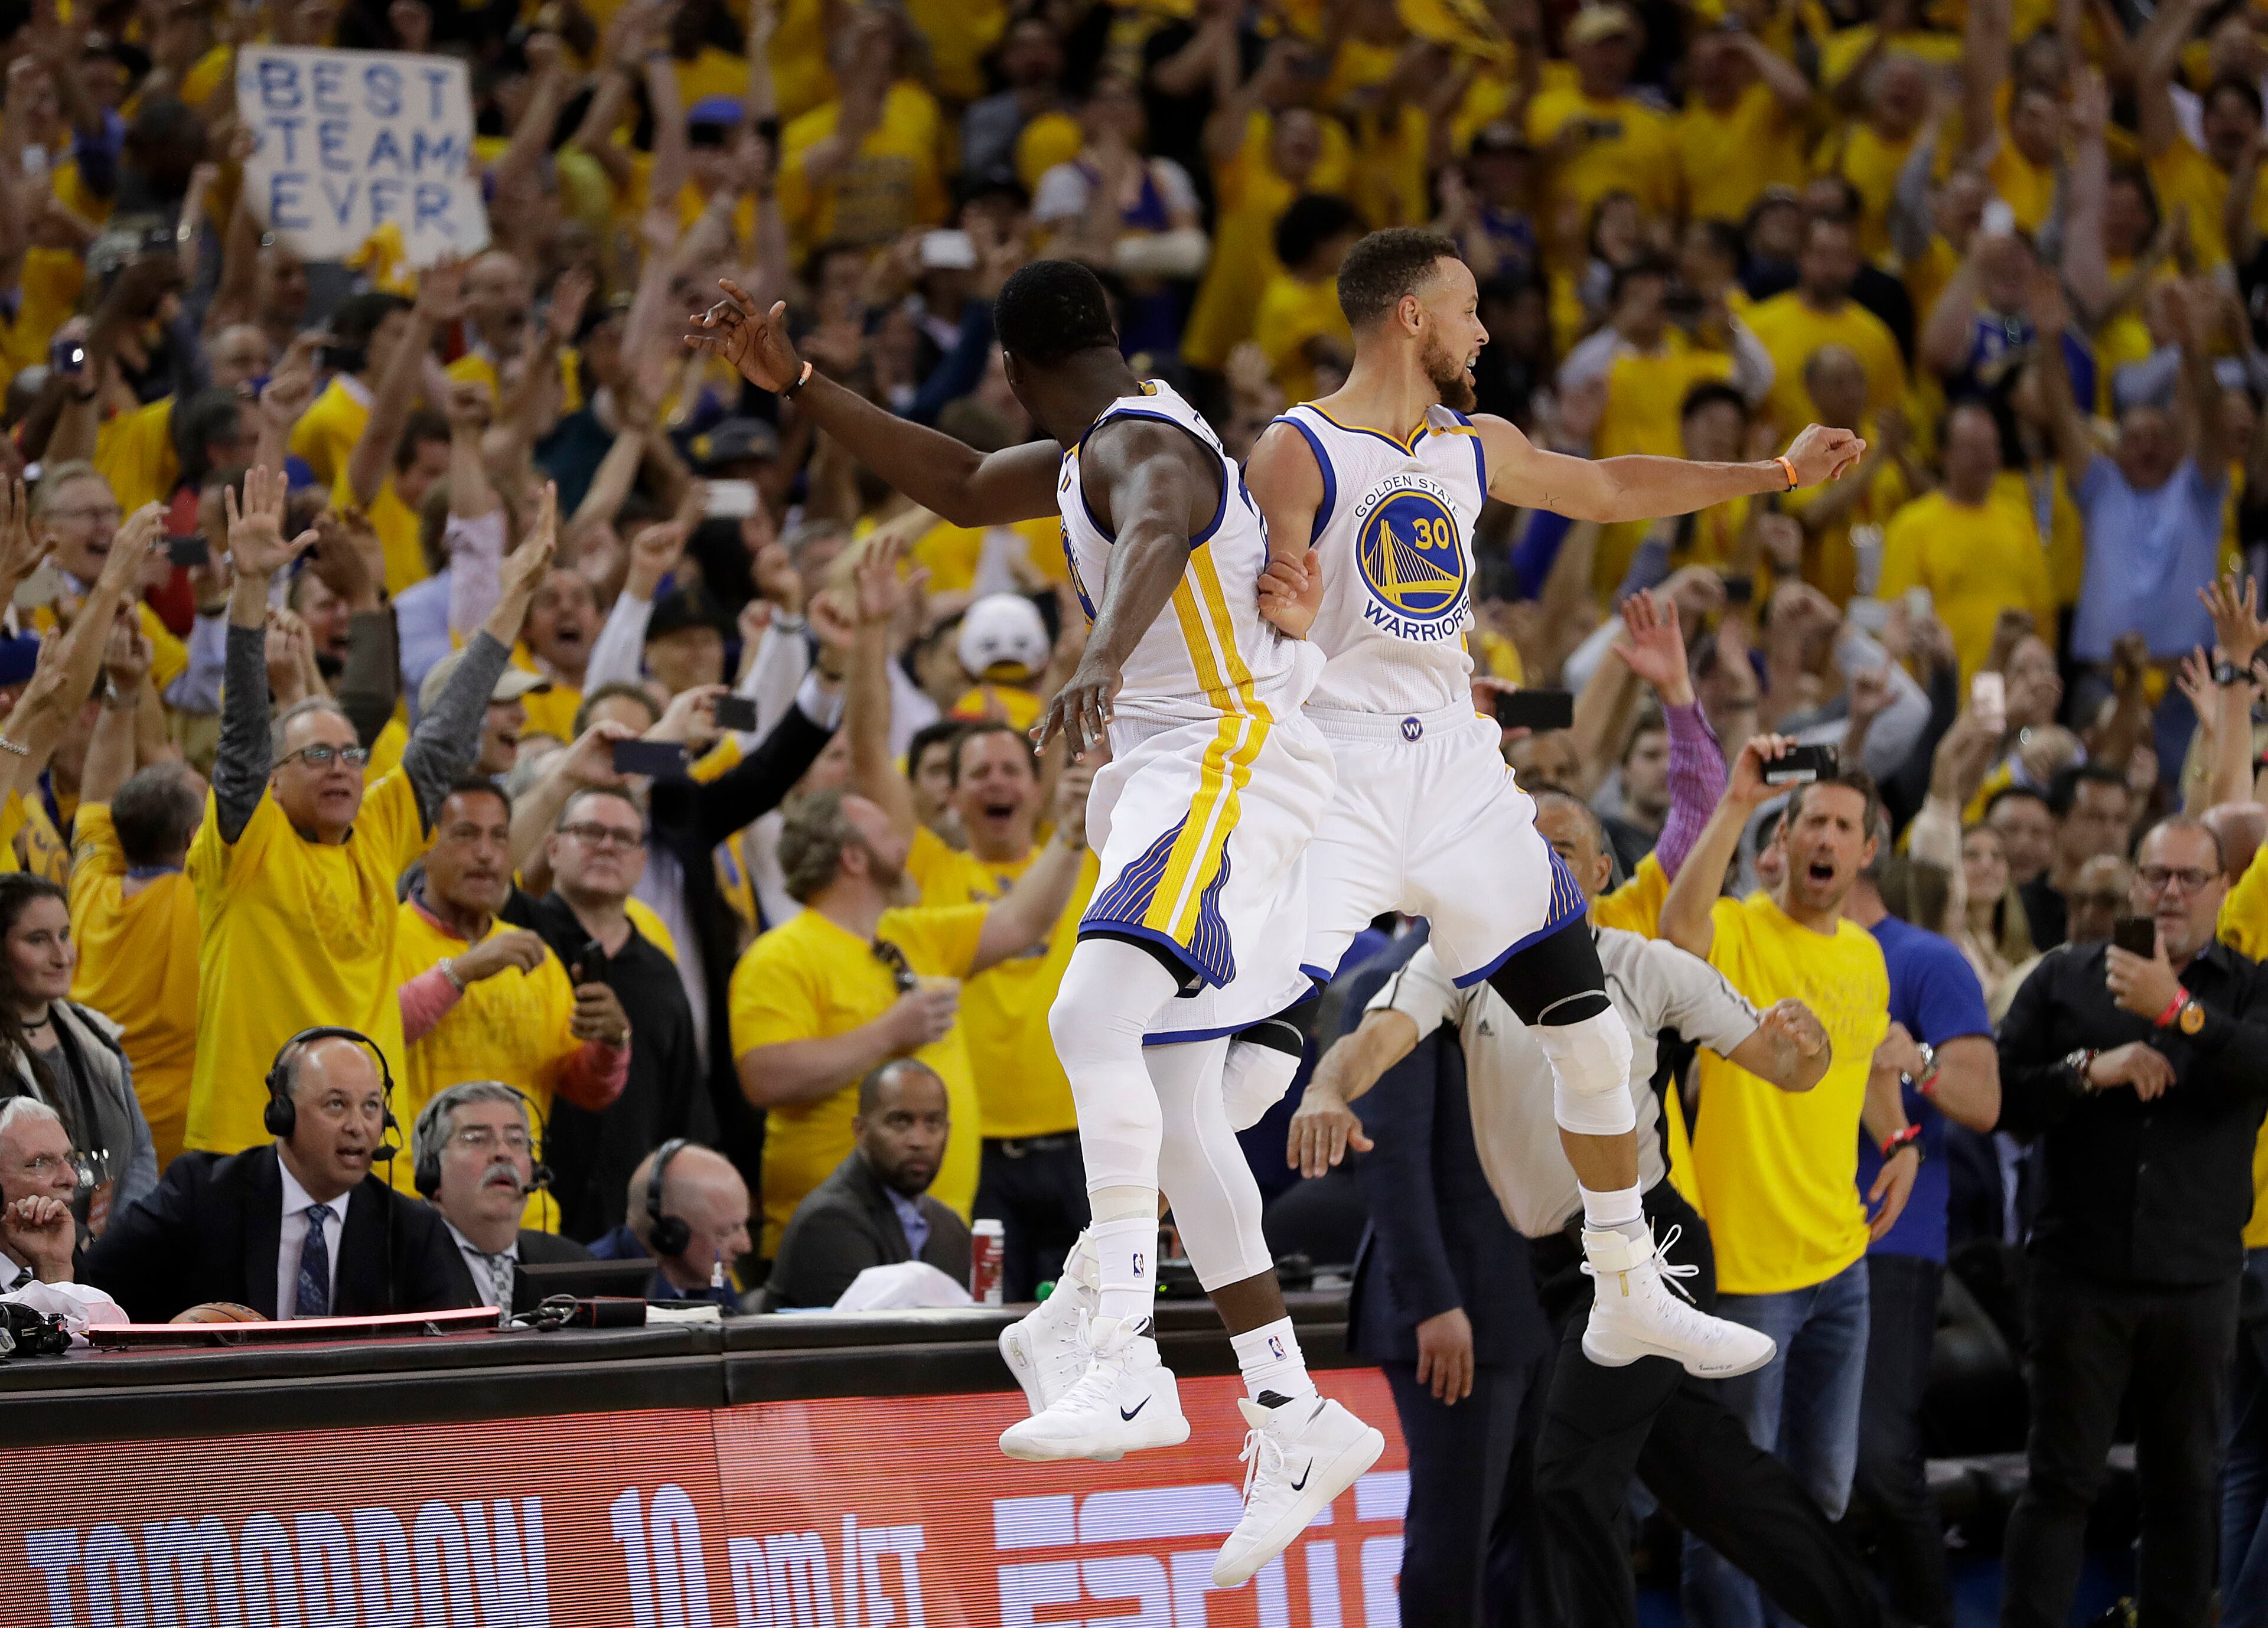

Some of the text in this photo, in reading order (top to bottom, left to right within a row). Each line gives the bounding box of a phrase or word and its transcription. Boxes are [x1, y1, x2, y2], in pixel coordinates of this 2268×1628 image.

[258, 59, 452, 120] BEST
[266, 116, 465, 174] TEAM
[270, 175, 458, 236] EVER
[1355, 475, 1459, 517] GOLDEN STATE
[1412, 517, 1450, 550] 30
[1364, 595, 1470, 641] WARRIORS
[1403, 723, 1420, 736] W
[25, 1496, 550, 1628] TOMORROW
[610, 1483, 712, 1628] 10
